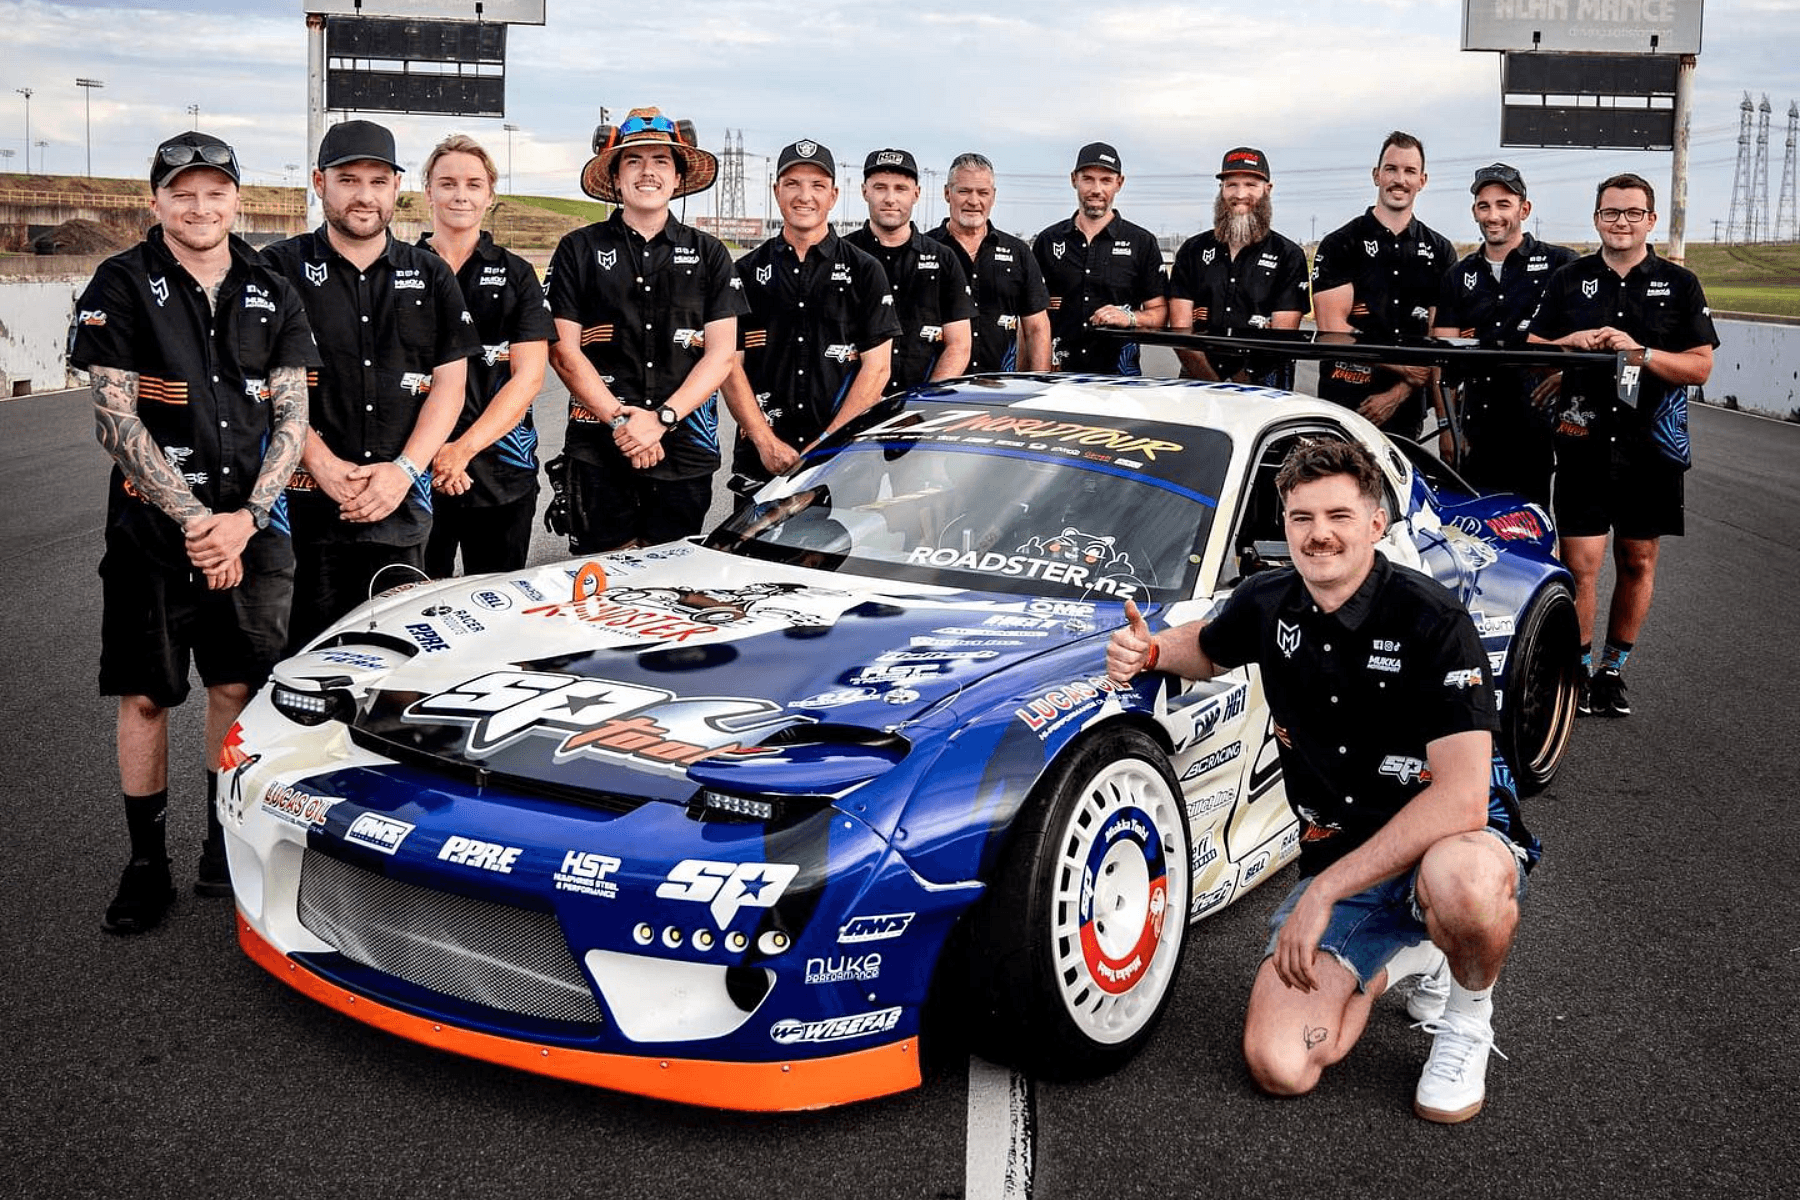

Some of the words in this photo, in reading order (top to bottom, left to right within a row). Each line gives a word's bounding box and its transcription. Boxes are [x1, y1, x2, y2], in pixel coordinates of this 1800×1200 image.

[907, 546, 1139, 600] ROADSTER.nz
[1368, 655, 1401, 667] MUKKA
[1015, 681, 1099, 732] LUCAS
[263, 781, 310, 818] LUCAS
[304, 797, 328, 826] OIL
[560, 850, 622, 880] HSP
[655, 859, 800, 931] SP
[805, 952, 882, 977] nuke
[804, 1009, 902, 1040] WISEFAB
